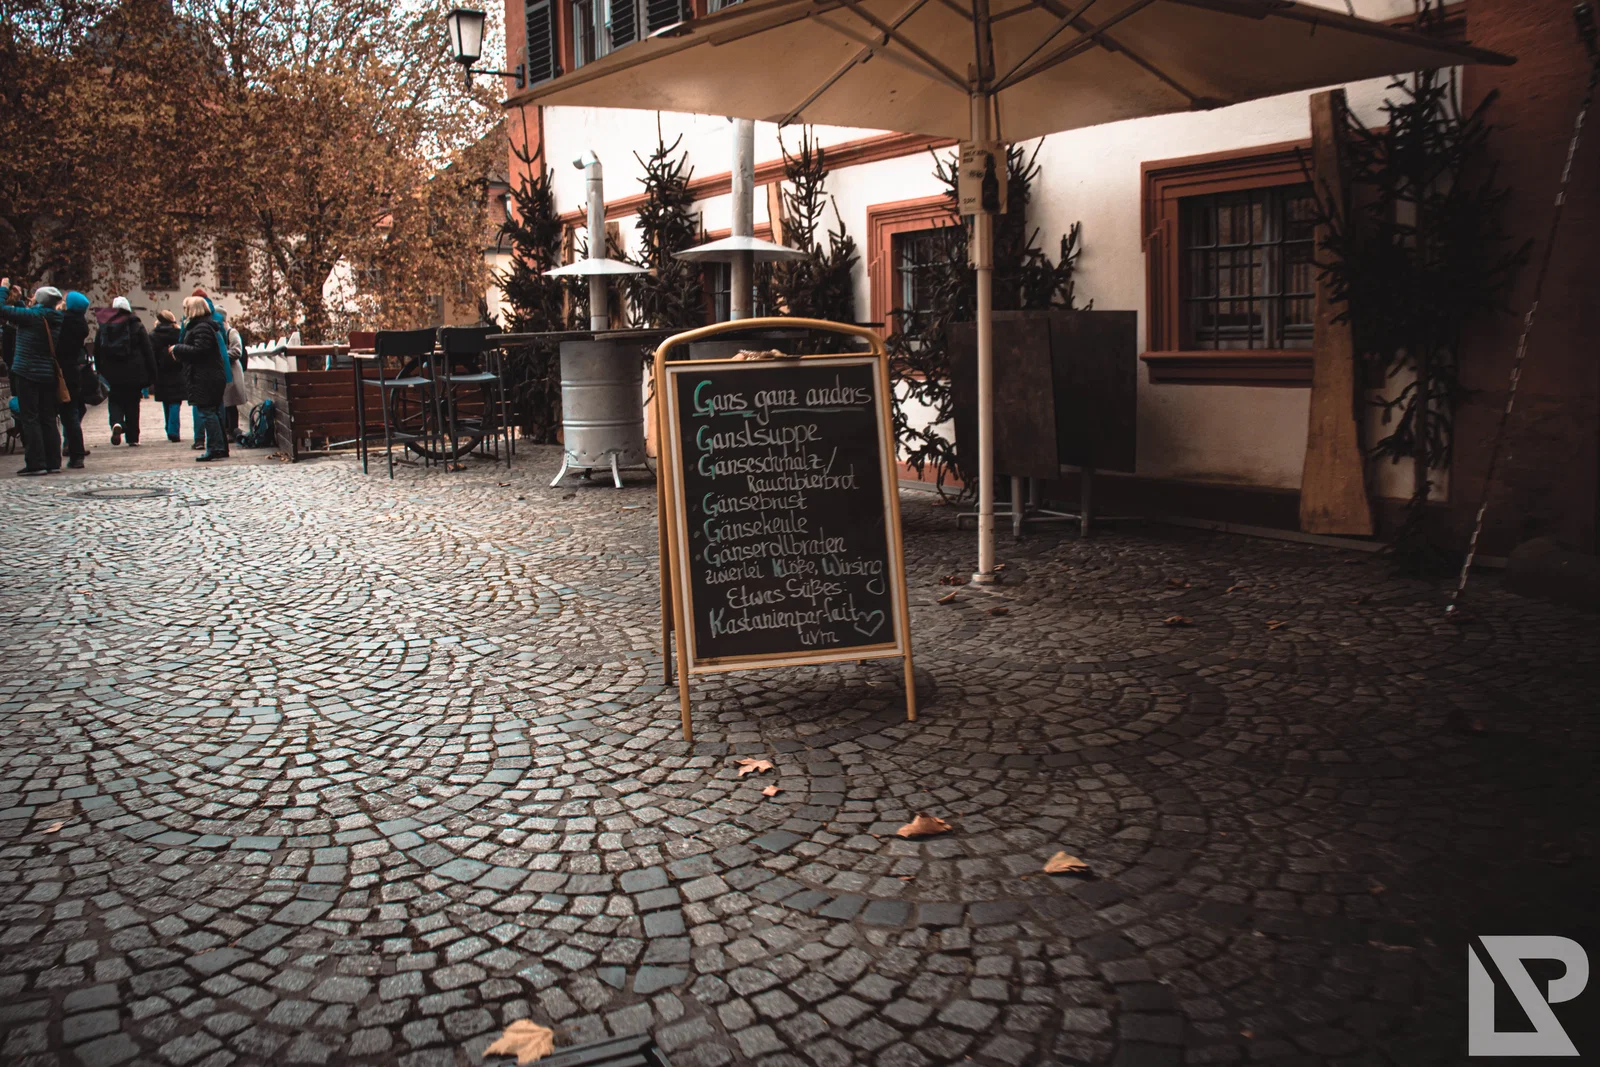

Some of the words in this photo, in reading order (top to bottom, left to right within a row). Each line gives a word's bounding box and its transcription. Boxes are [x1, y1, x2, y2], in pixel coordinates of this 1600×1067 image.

[693, 380, 748, 417] Gans
[754, 388, 799, 425] ganz
[806, 374, 872, 406] anders
[696, 420, 823, 458] Ganslsuppe
[747, 463, 860, 493] Rauchbierbrot
[702, 491, 808, 517] Gänsebrust
[703, 510, 809, 543] Gänsekeule
[703, 526, 847, 567] Gänserollbraten
[822, 554, 885, 595] Wirsing
[709, 593, 860, 638] Kastanienparfait
[726, 585, 786, 609] Etwas
